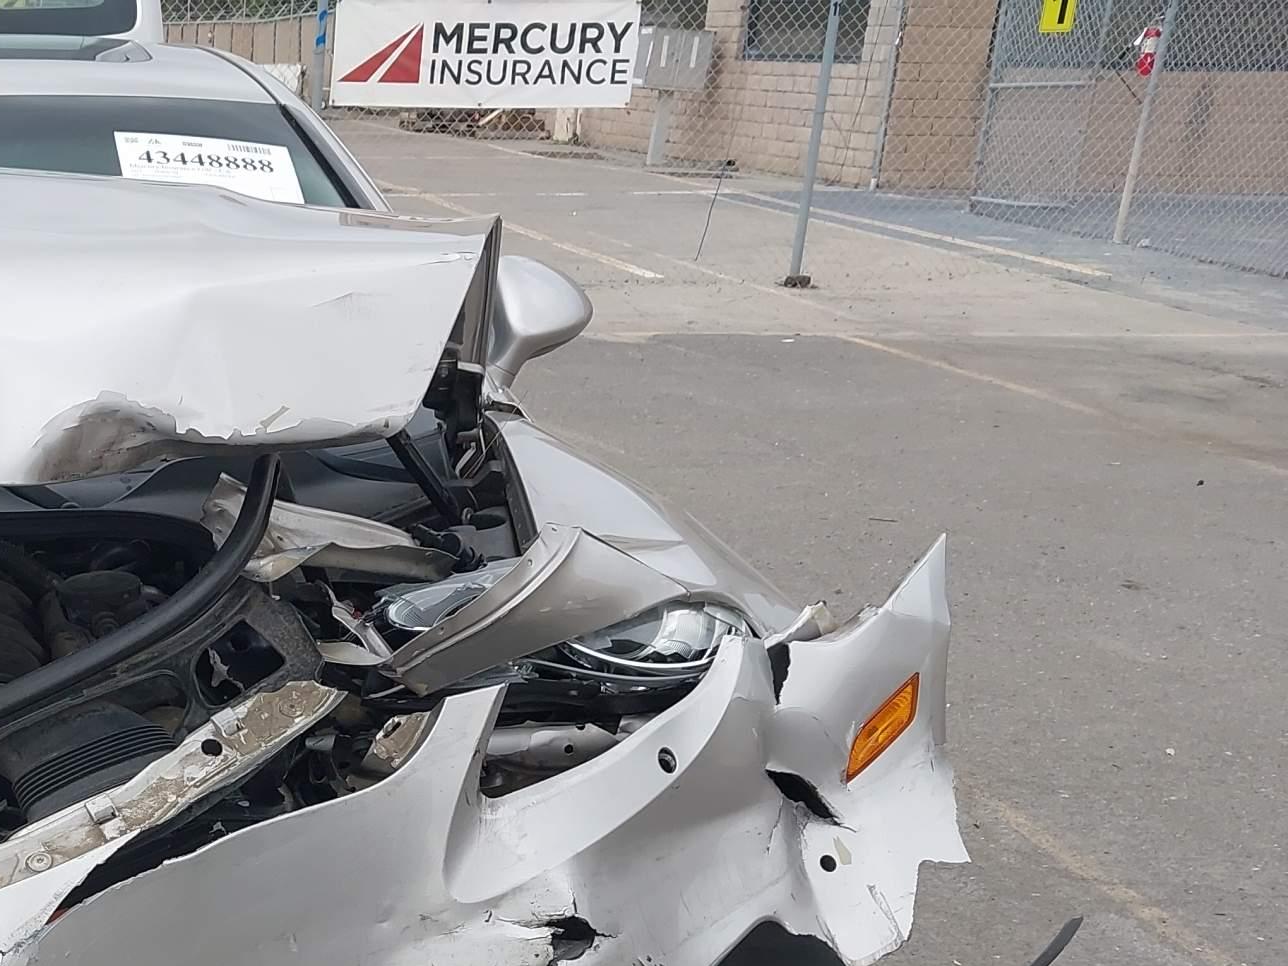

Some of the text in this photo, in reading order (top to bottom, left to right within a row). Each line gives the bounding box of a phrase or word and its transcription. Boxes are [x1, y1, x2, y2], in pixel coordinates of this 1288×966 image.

[432, 22, 633, 54] MERCURY
[429, 59, 630, 85] INSURANCE
[138, 150, 274, 174] 43448888
